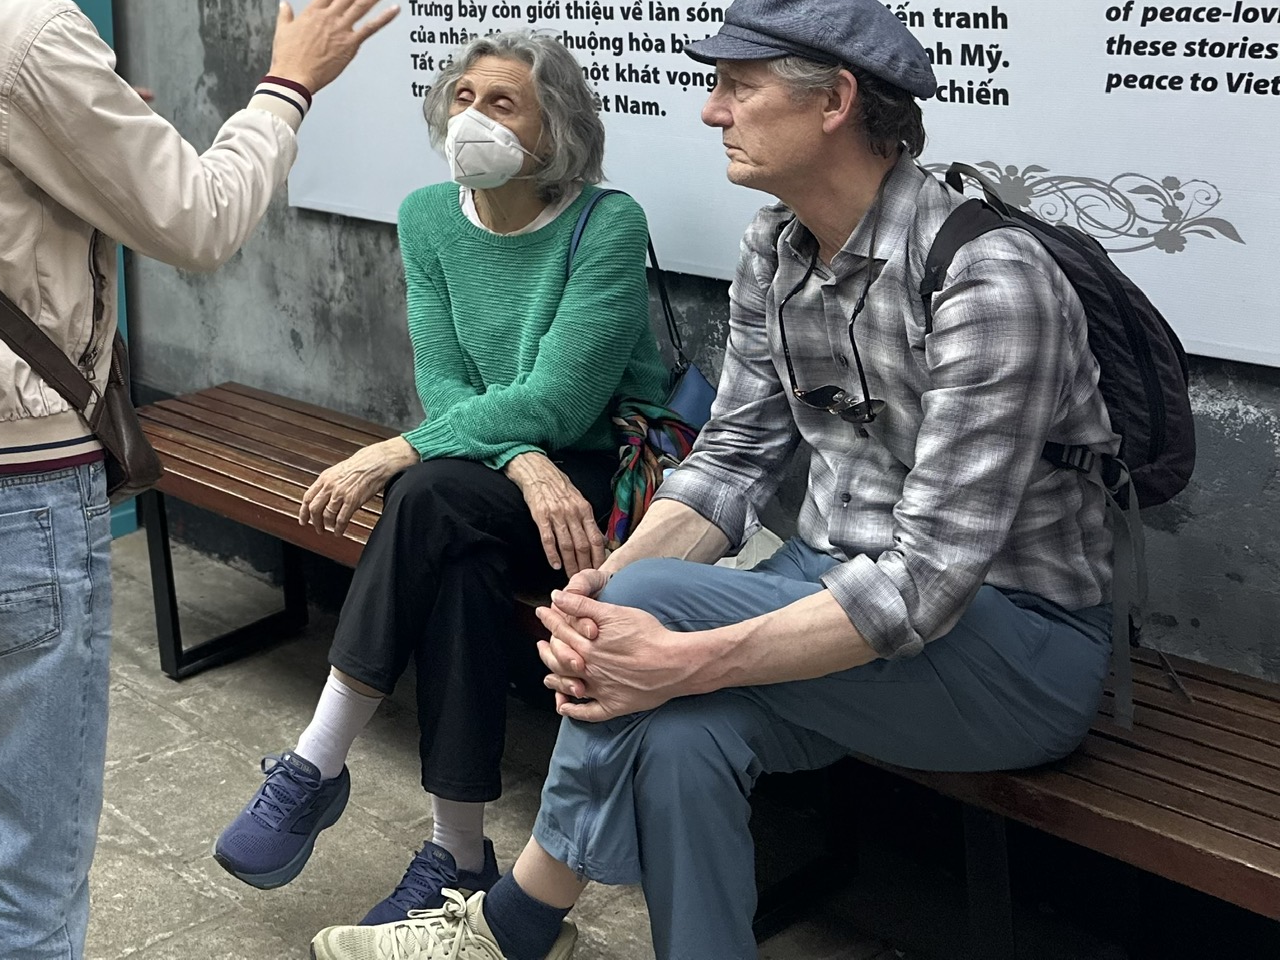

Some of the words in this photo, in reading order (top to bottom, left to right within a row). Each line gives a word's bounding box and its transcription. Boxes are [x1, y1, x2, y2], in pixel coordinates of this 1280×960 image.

[409, 0, 453, 22] Trưng
[458, 0, 487, 23] bày
[492, 0, 521, 19] còn
[526, 0, 561, 24] giới
[565, 0, 614, 25] thiệu
[649, 1, 680, 21] làn
[686, 2, 726, 23] són
[933, 6, 1008, 29] tranh
[1106, 0, 1134, 21] of
[410, 25, 435, 43] của
[629, 32, 665, 53] hòa
[1106, 34, 1177, 56] these
[1183, 36, 1279, 59] stories
[410, 51, 434, 71] Tất
[961, 43, 1010, 74] Mỹ.
[615, 63, 660, 84] khát
[1105, 73, 1183, 93] peace
[1190, 73, 1218, 92] to
[936, 78, 1009, 106] chiến
[615, 94, 667, 117] Nam.
